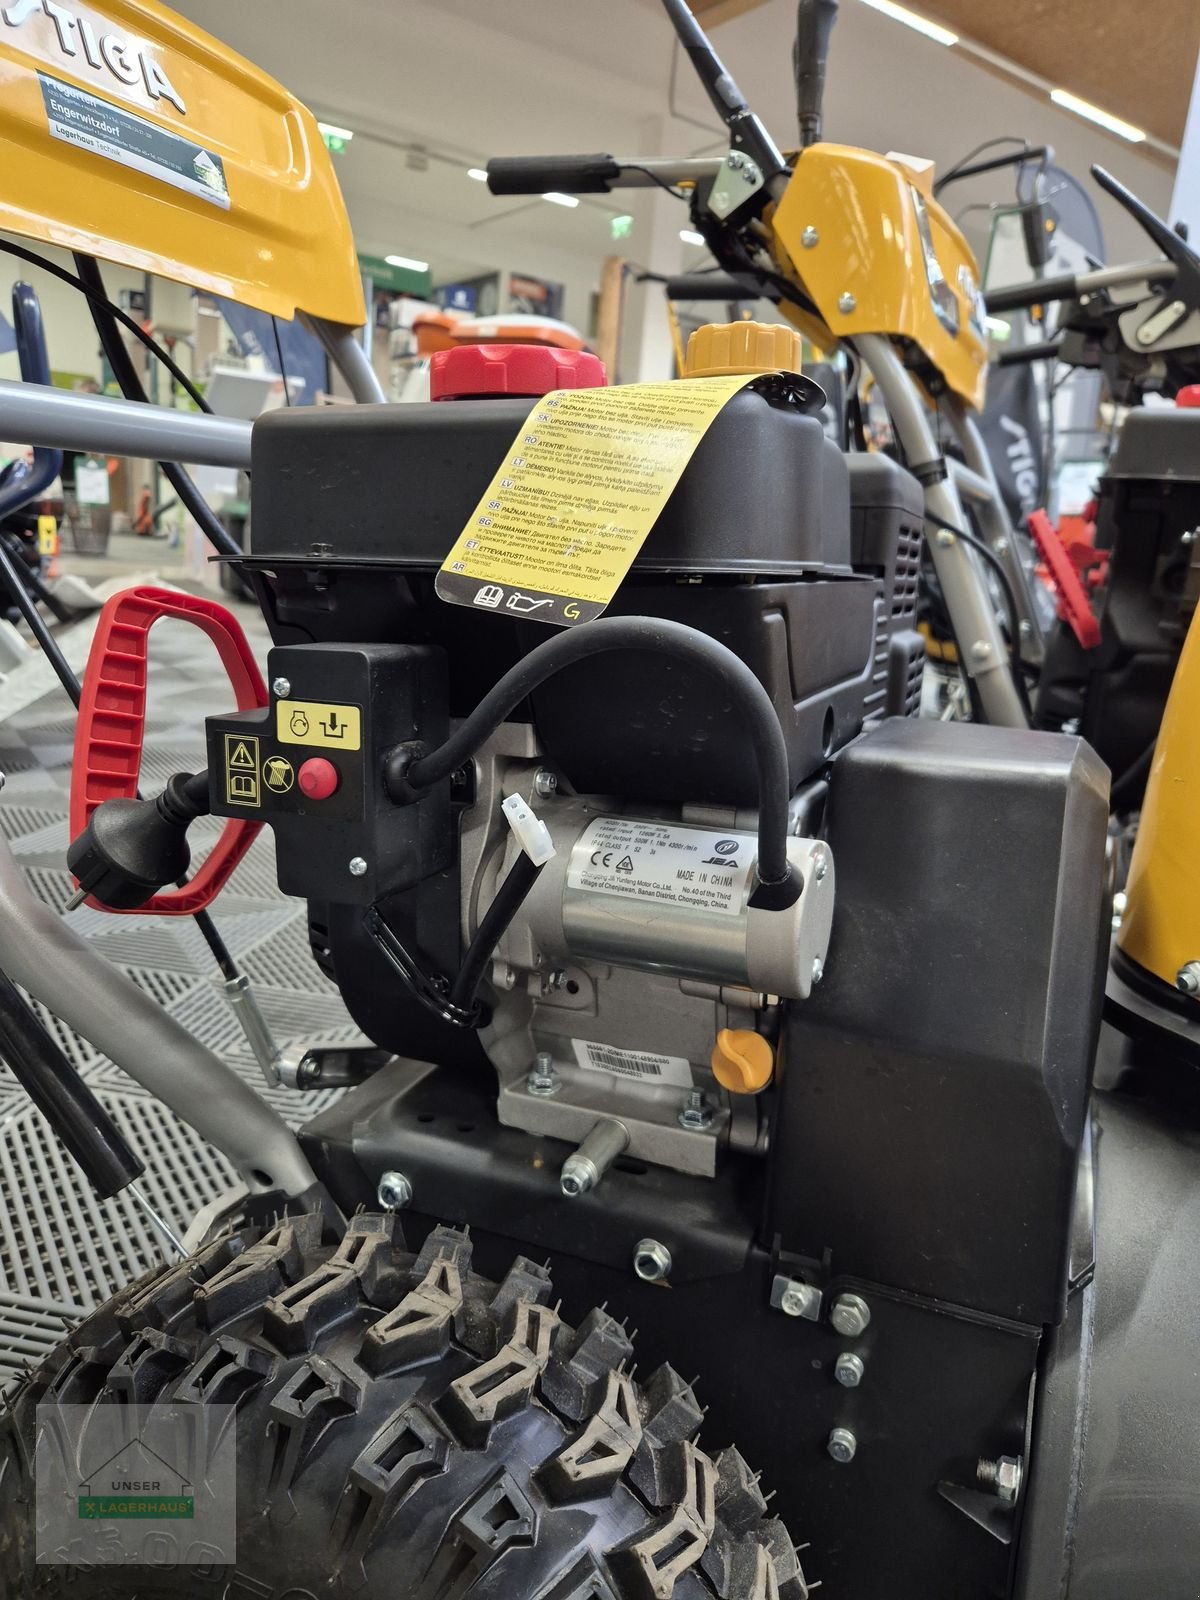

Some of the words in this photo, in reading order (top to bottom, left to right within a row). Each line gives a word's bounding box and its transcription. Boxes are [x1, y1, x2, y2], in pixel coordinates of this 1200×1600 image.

[50, 99, 120, 137] Engerwitzdorf
[56, 124, 95, 146] Lagerhaus
[96, 140, 121, 156] Technik
[550, 418, 599, 430] UPOZORNENIE!
[488, 501, 500, 509] SR
[501, 505, 527, 516] PAŽNJA!
[571, 519, 596, 528] Napuniti
[466, 540, 477, 548] ET
[482, 529, 514, 539] проверете
[514, 535, 536, 543] нивото
[491, 523, 531, 534] ВНИМАНИЕ!
[530, 530, 559, 540] Двигател
[594, 542, 626, 553] Заредете
[506, 540, 539, 550] двигателя
[478, 545, 524, 559] ETTEVAATUST!
[525, 555, 545, 564] Mootor
[452, 562, 464, 570] AR
[470, 551, 500, 561] kontrollida
[537, 565, 560, 574] mootori
[561, 568, 601, 581] esmakordset
[599, 824, 616, 832] rated
[612, 834, 631, 842] output
[701, 855, 739, 868] JEA
[676, 869, 694, 881] MADE
[698, 872, 707, 882] IN
[710, 874, 733, 887] CHINA
[580, 878, 598, 887] Village
[603, 882, 637, 894] Chenjiawan,
[637, 888, 655, 896] Banan
[655, 891, 677, 901] District,
[677, 894, 710, 907] Chongqing,
[710, 900, 729, 909] China.
[615, 876, 636, 886] Yunfeng
[681, 886, 698, 895] No.40
[716, 892, 731, 900] Third
